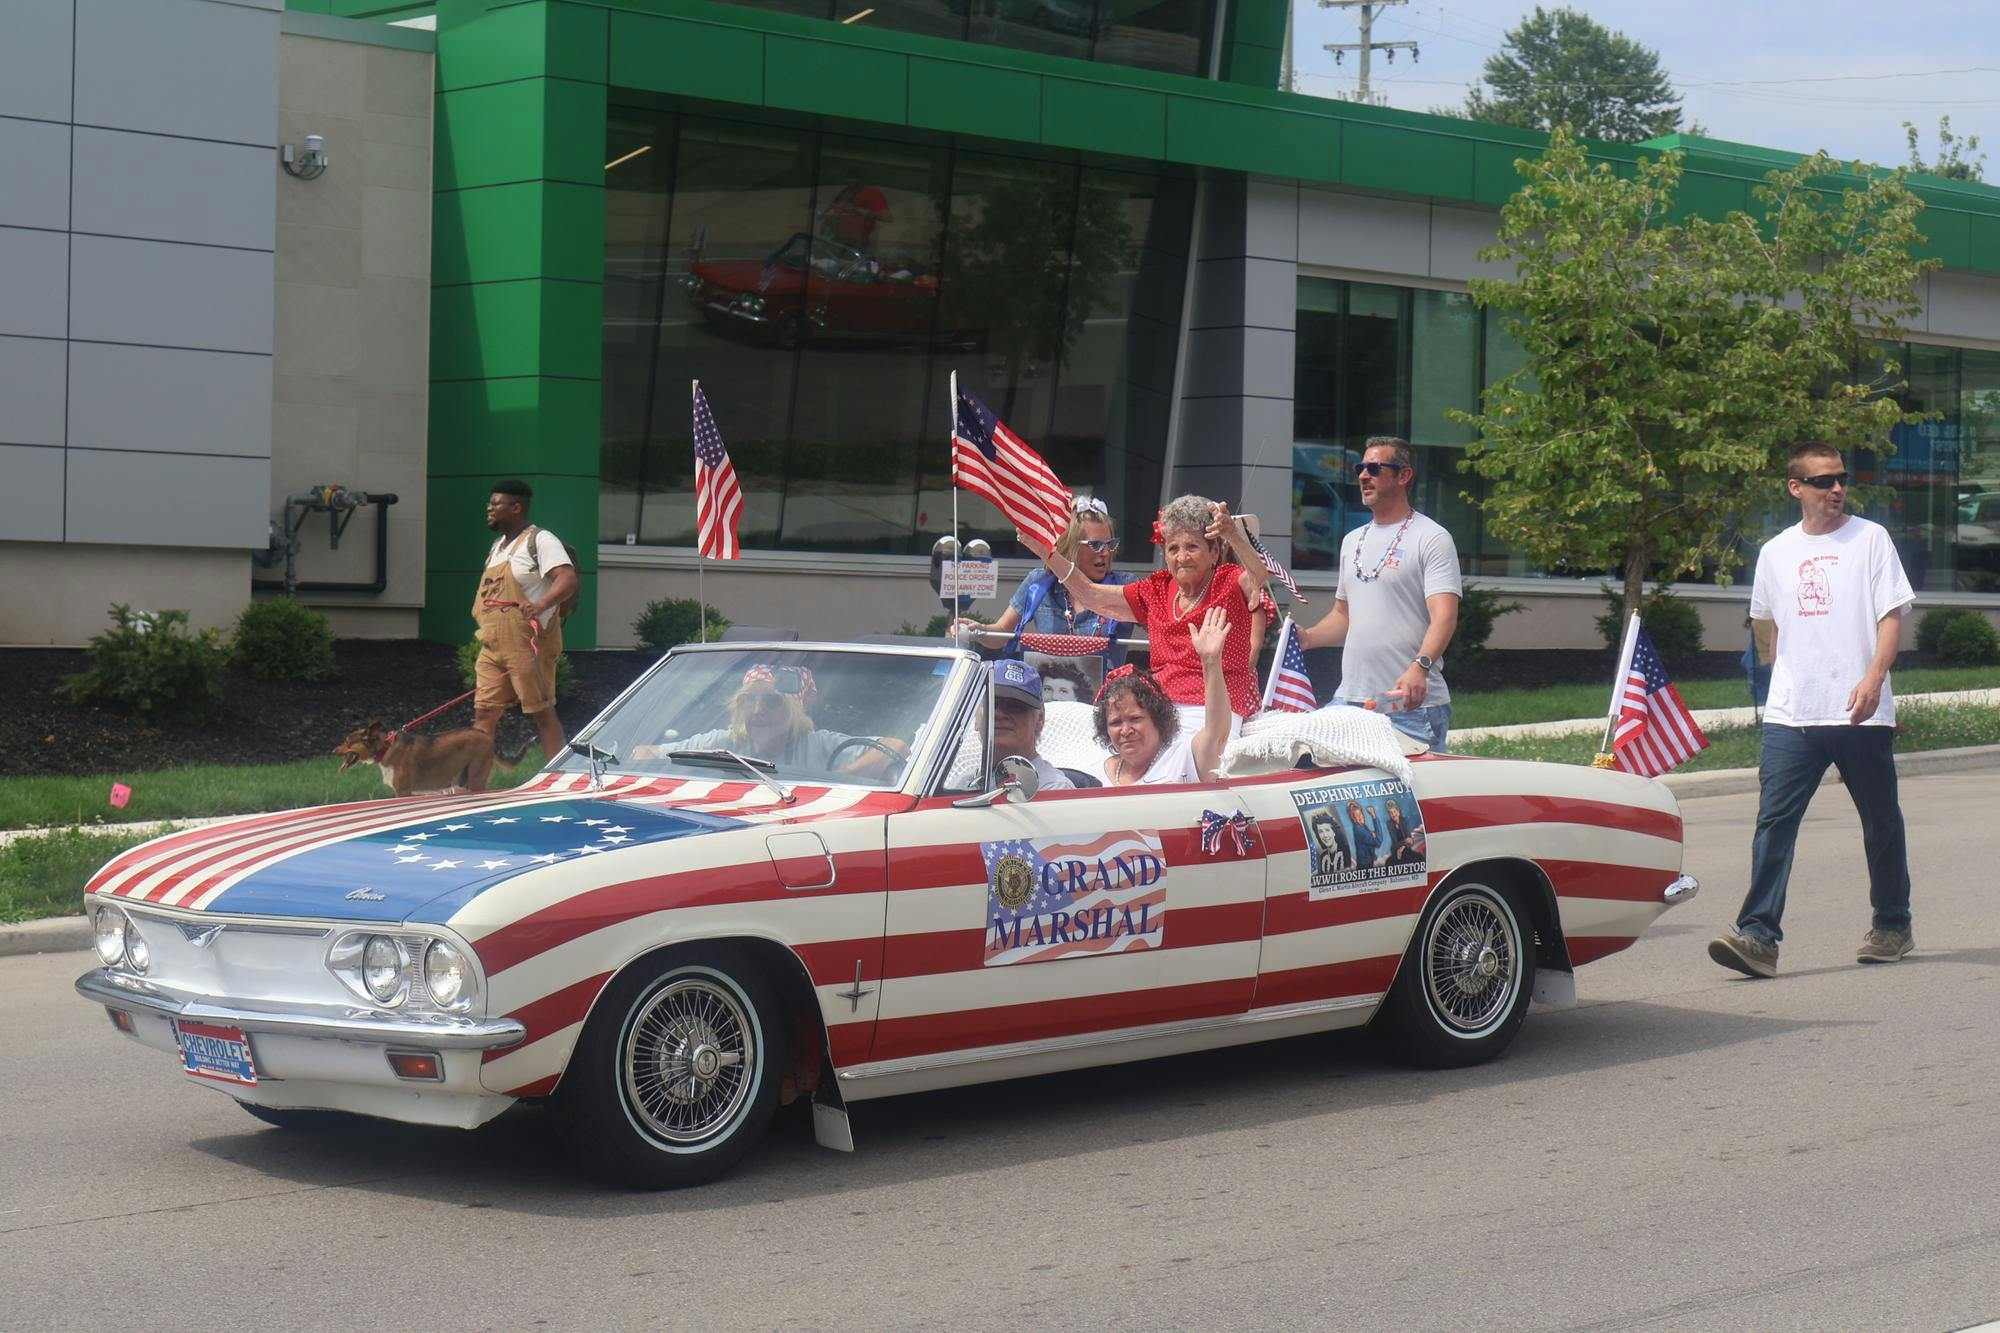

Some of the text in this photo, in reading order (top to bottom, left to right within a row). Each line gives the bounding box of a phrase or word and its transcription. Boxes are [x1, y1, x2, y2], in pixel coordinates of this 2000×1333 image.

[1007, 671, 1022, 681] 66
[1293, 788, 1362, 806] DELPHINE
[1041, 854, 1161, 896] GRAND
[1311, 861, 1426, 886] WWII ROSIE THE RIVETOR
[1368, 879, 1388, 887] Company
[991, 903, 1159, 951] MARSHAL
[182, 1033, 245, 1060] CHEVROLET
